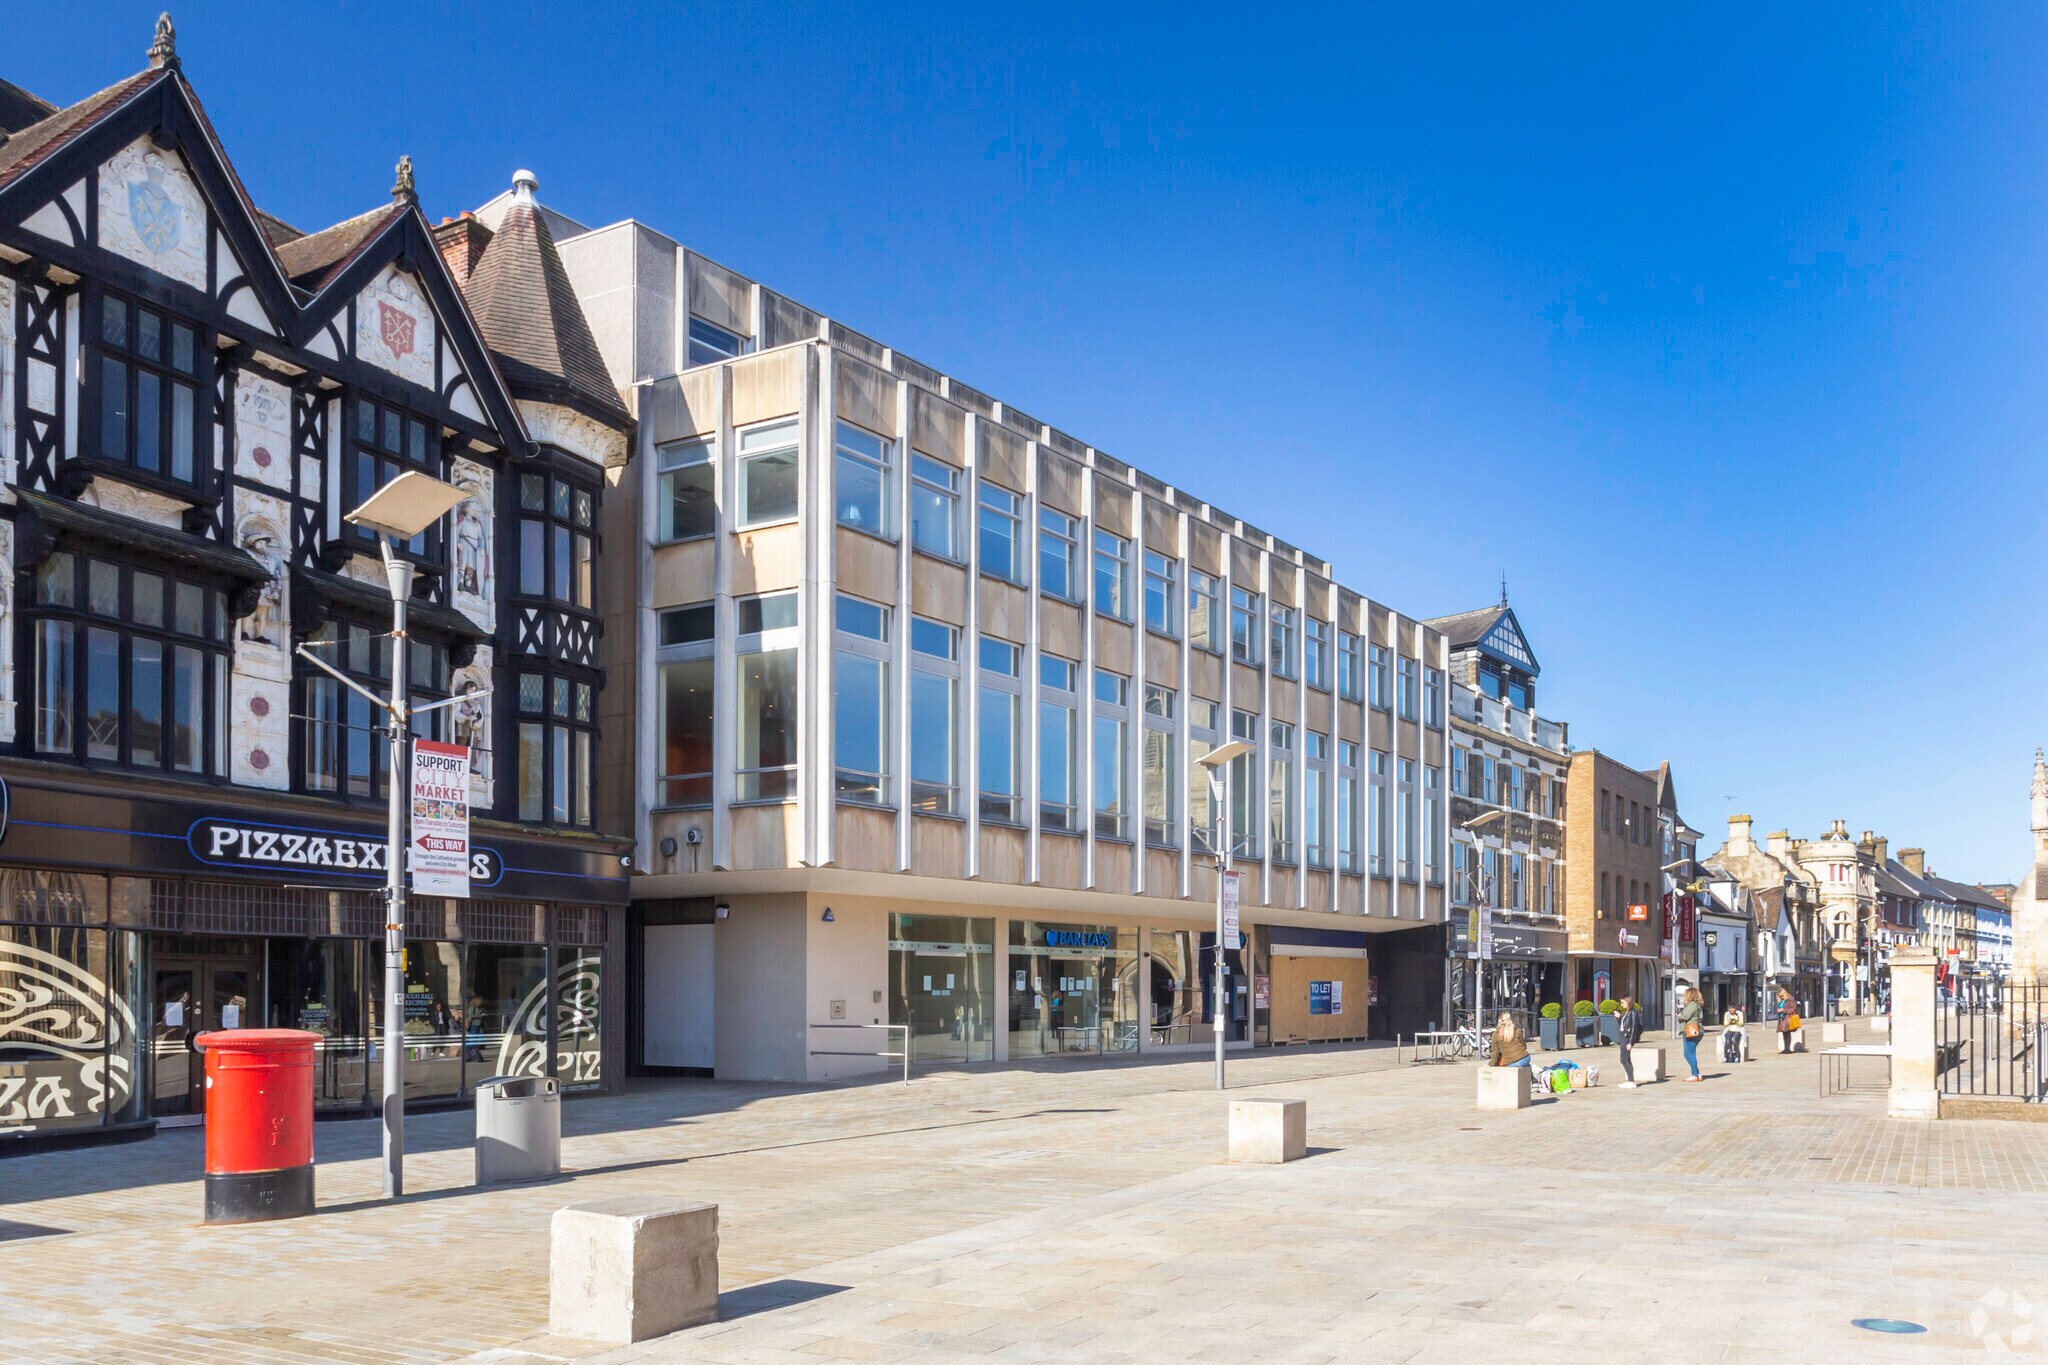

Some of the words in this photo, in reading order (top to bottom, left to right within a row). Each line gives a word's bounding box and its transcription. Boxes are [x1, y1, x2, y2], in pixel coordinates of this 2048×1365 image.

[416, 754, 463, 772] SUPPORT
[416, 767, 466, 788] CITY
[414, 783, 465, 801] MARKET
[413, 817, 426, 826] Open
[448, 821, 467, 830] Saturday
[424, 837, 445, 850] THIS
[444, 839, 464, 851] WAY
[1059, 931, 1111, 948] BARCLAYS
[1310, 983, 1320, 993] TO
[1320, 983, 1331, 993] LET
